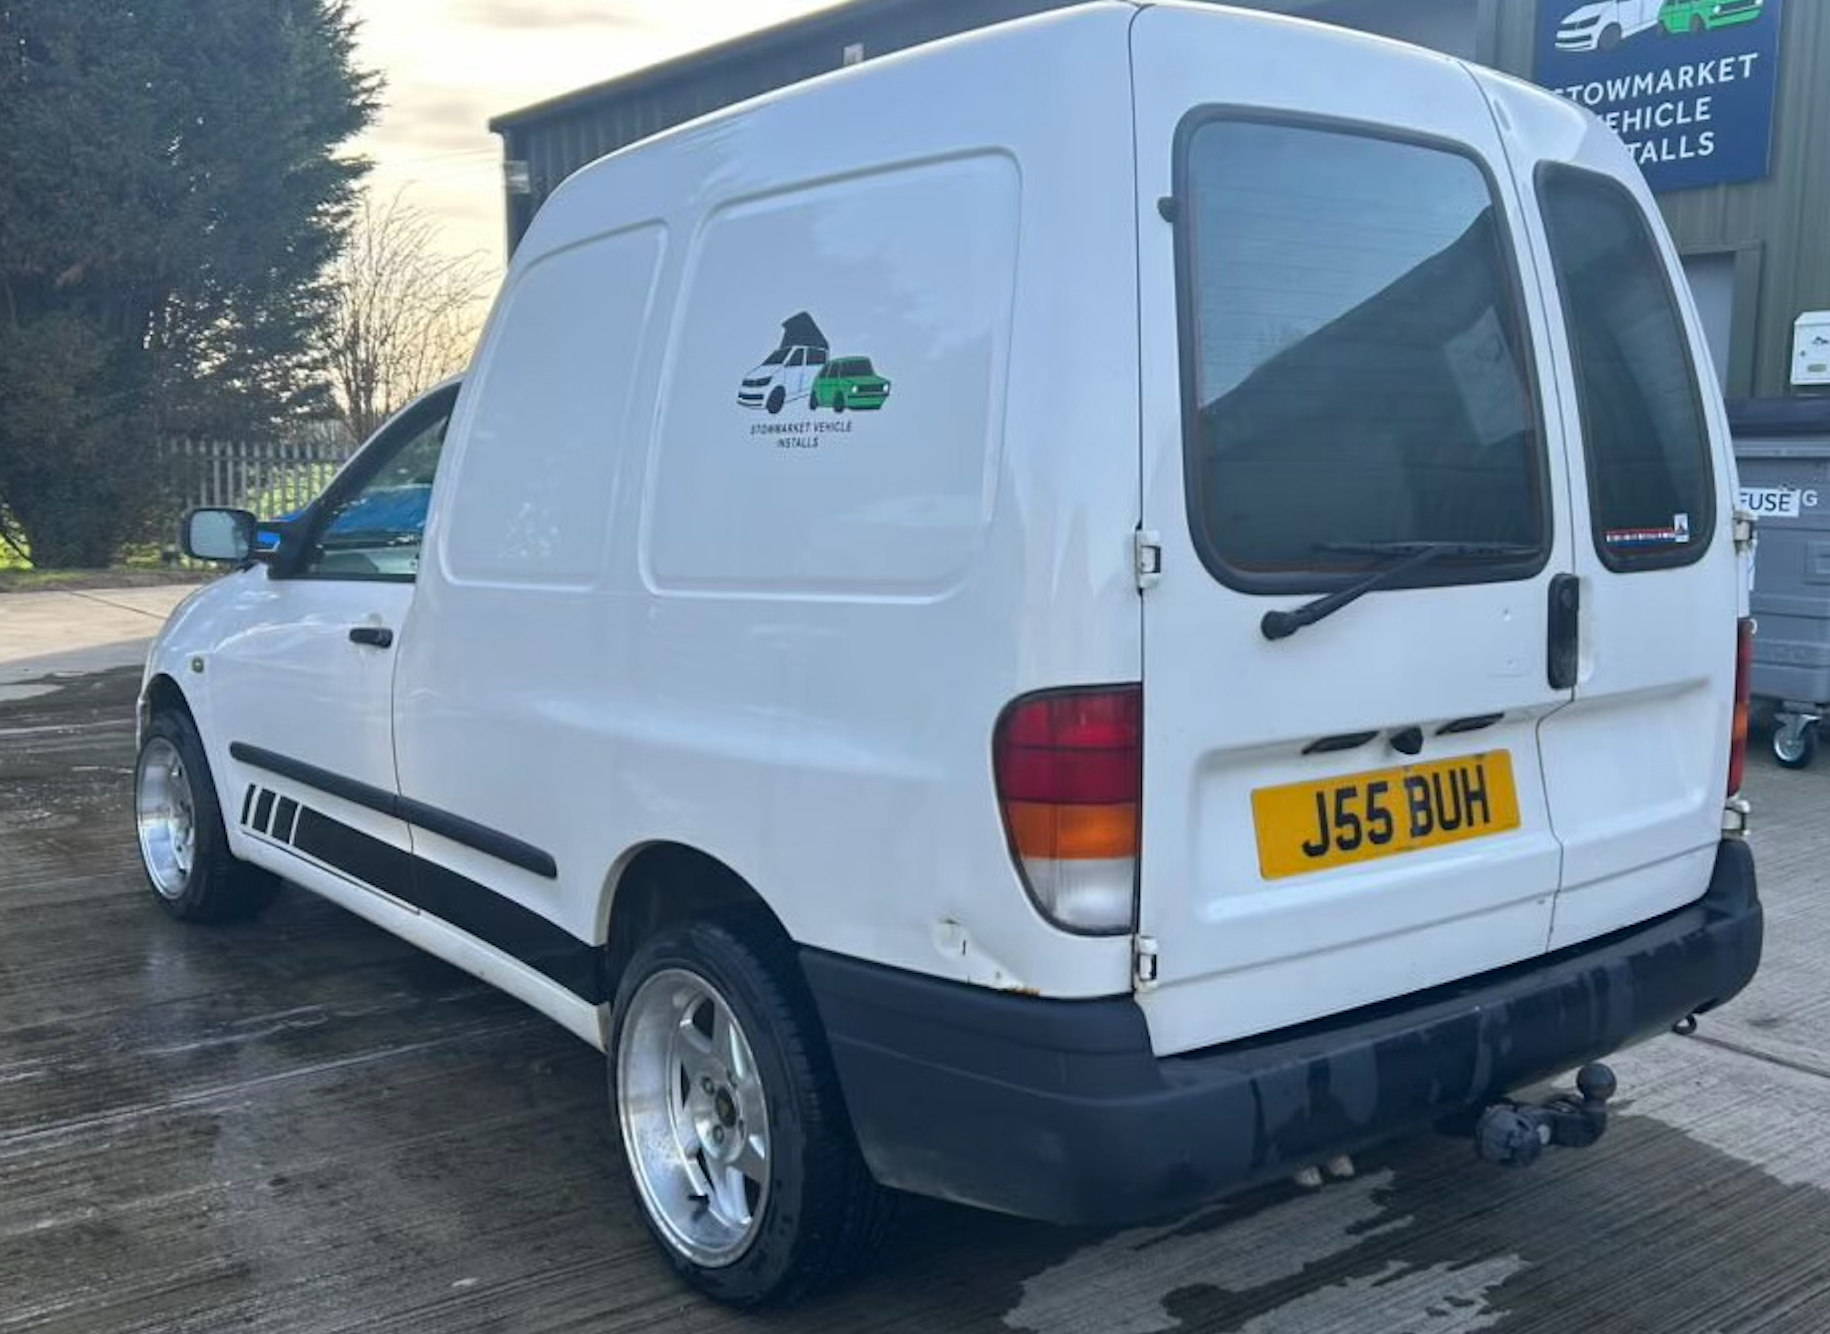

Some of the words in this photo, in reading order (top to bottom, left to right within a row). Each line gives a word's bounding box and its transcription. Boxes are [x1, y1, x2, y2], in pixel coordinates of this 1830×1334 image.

[1553, 52, 1759, 106] TOWMARKET
[1597, 96, 1712, 134] EHICLE
[1302, 782, 1394, 859] J55
[1404, 764, 1491, 839] BUH
